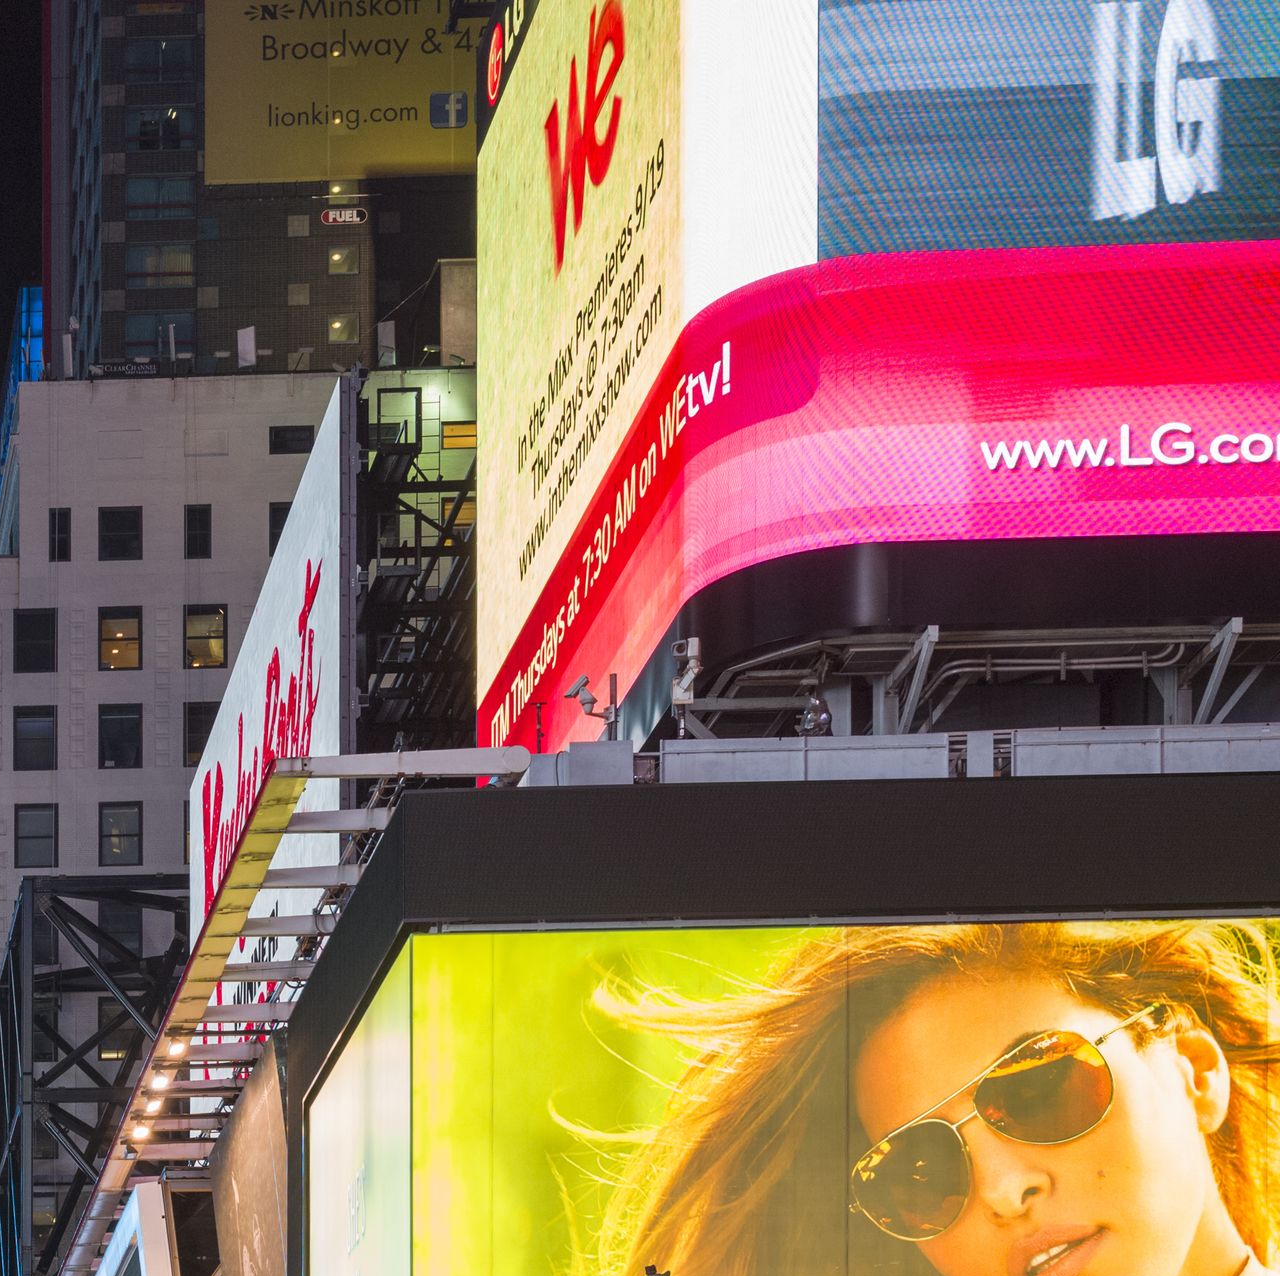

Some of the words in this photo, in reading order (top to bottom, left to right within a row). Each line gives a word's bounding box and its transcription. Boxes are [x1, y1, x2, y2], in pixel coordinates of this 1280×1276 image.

[262, 29, 409, 64] Broadway
[421, 27, 443, 55] &
[268, 101, 418, 130] lionking.com
[326, 210, 361, 223] FUEL
[529, 396, 546, 450] the
[547, 335, 574, 412] Mixx
[576, 213, 633, 356] Premieres
[635, 138, 665, 232] 9/19
[531, 376, 583, 500] Thursdays
[586, 340, 598, 399] @
[601, 253, 645, 365] 7:30am
[511, 605, 566, 724] Thursdays
[567, 575, 580, 628] at
[582, 512, 611, 599] 7:30
[613, 463, 636, 548] AM
[639, 442, 657, 498] on
